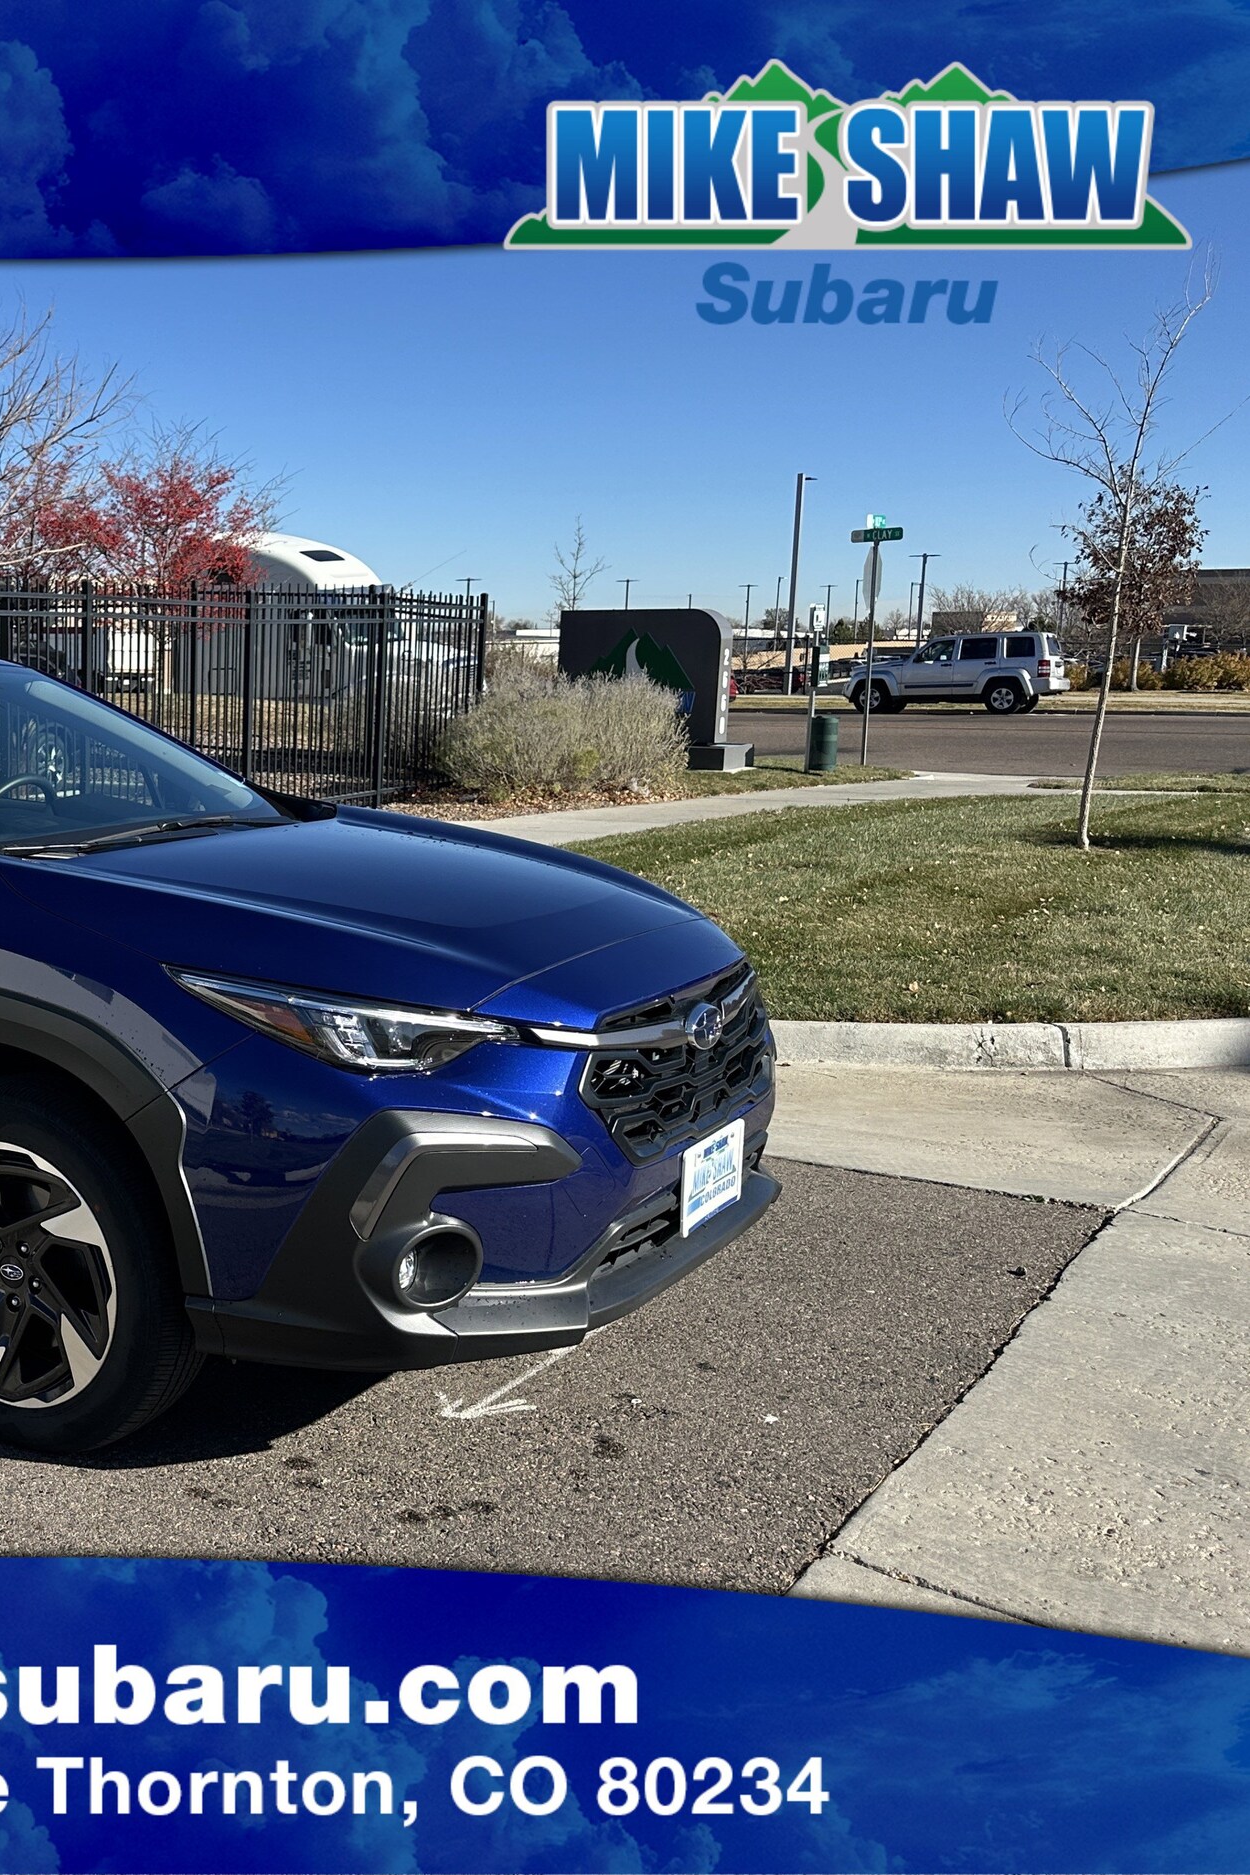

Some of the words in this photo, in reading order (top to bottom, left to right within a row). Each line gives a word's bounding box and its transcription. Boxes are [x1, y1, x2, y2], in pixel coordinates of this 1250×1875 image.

[872, 529, 893, 540] CLAY
[693, 1166, 711, 1194] MIKE
[712, 1148, 734, 1180] SHAW
[700, 1175, 736, 1206] COLORADO
